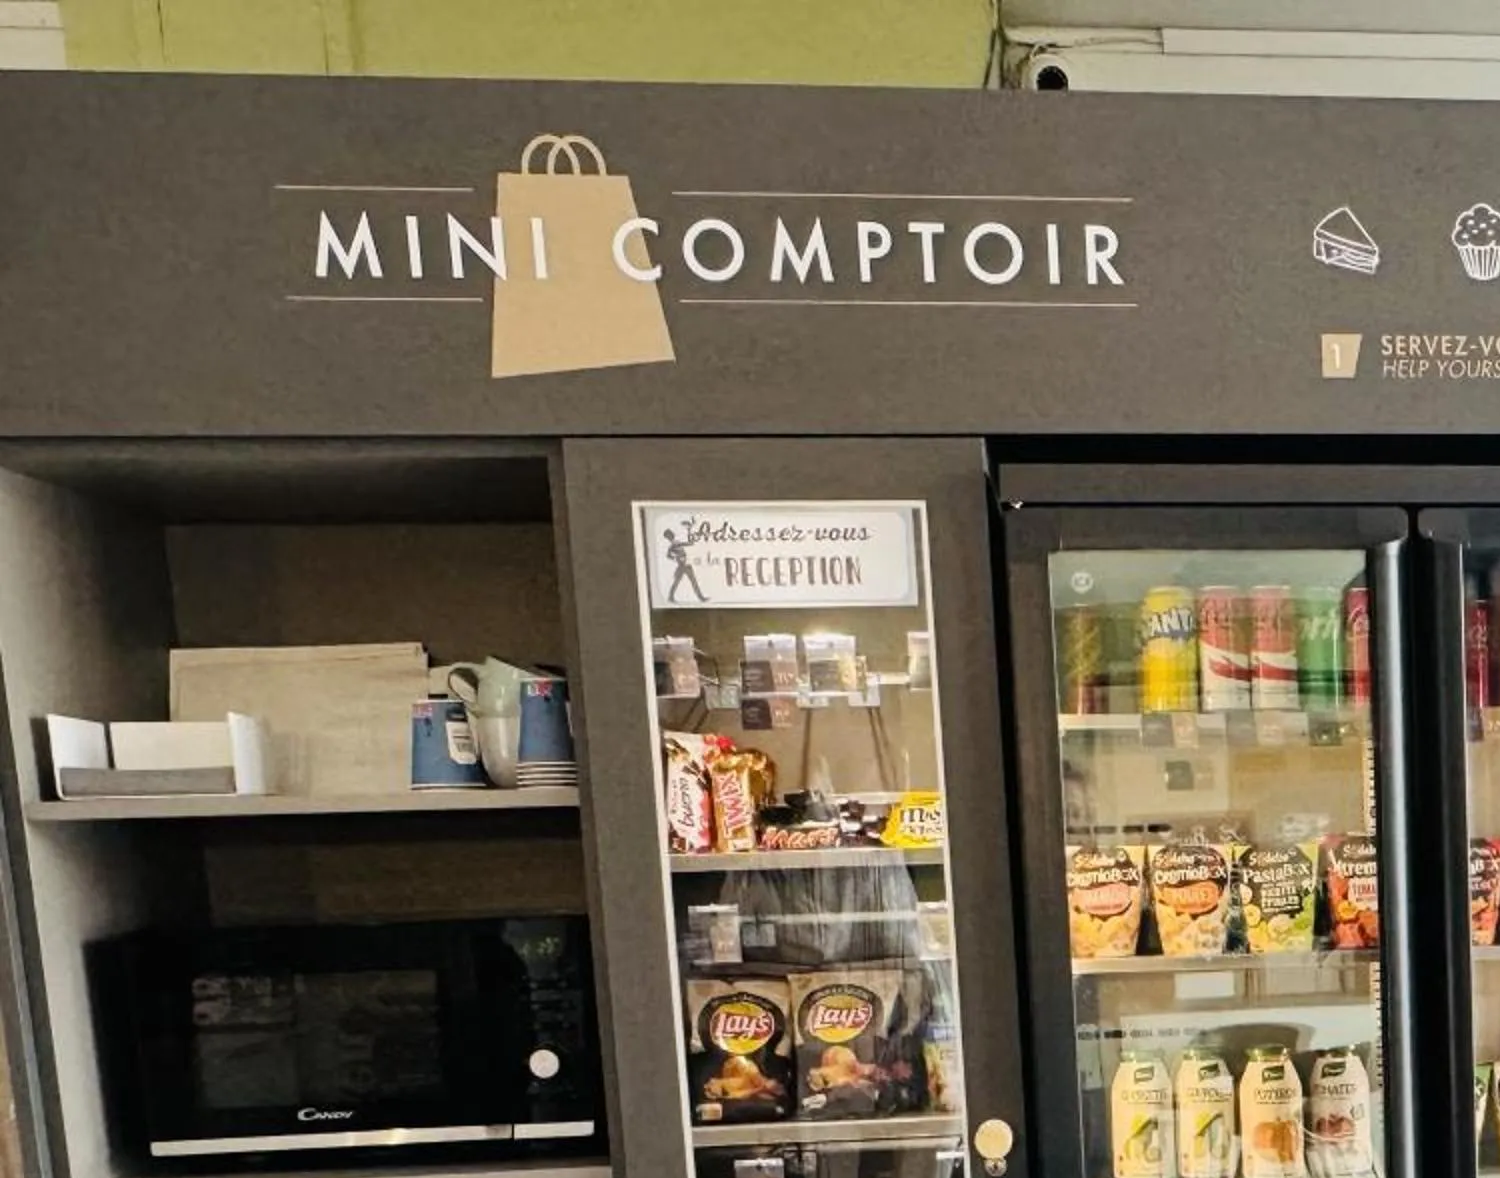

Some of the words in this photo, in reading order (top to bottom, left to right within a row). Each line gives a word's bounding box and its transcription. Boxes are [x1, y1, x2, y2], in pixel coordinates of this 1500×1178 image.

[314, 209, 549, 282] MINI
[611, 214, 1126, 286] COMPTOIR
[1332, 342, 1341, 369] 1
[1382, 359, 1430, 379] HELP
[692, 520, 871, 544] Adressez-vous
[724, 555, 863, 588] RECEPTION
[715, 1010, 771, 1041] Lay's
[813, 1004, 869, 1031] Lay's
